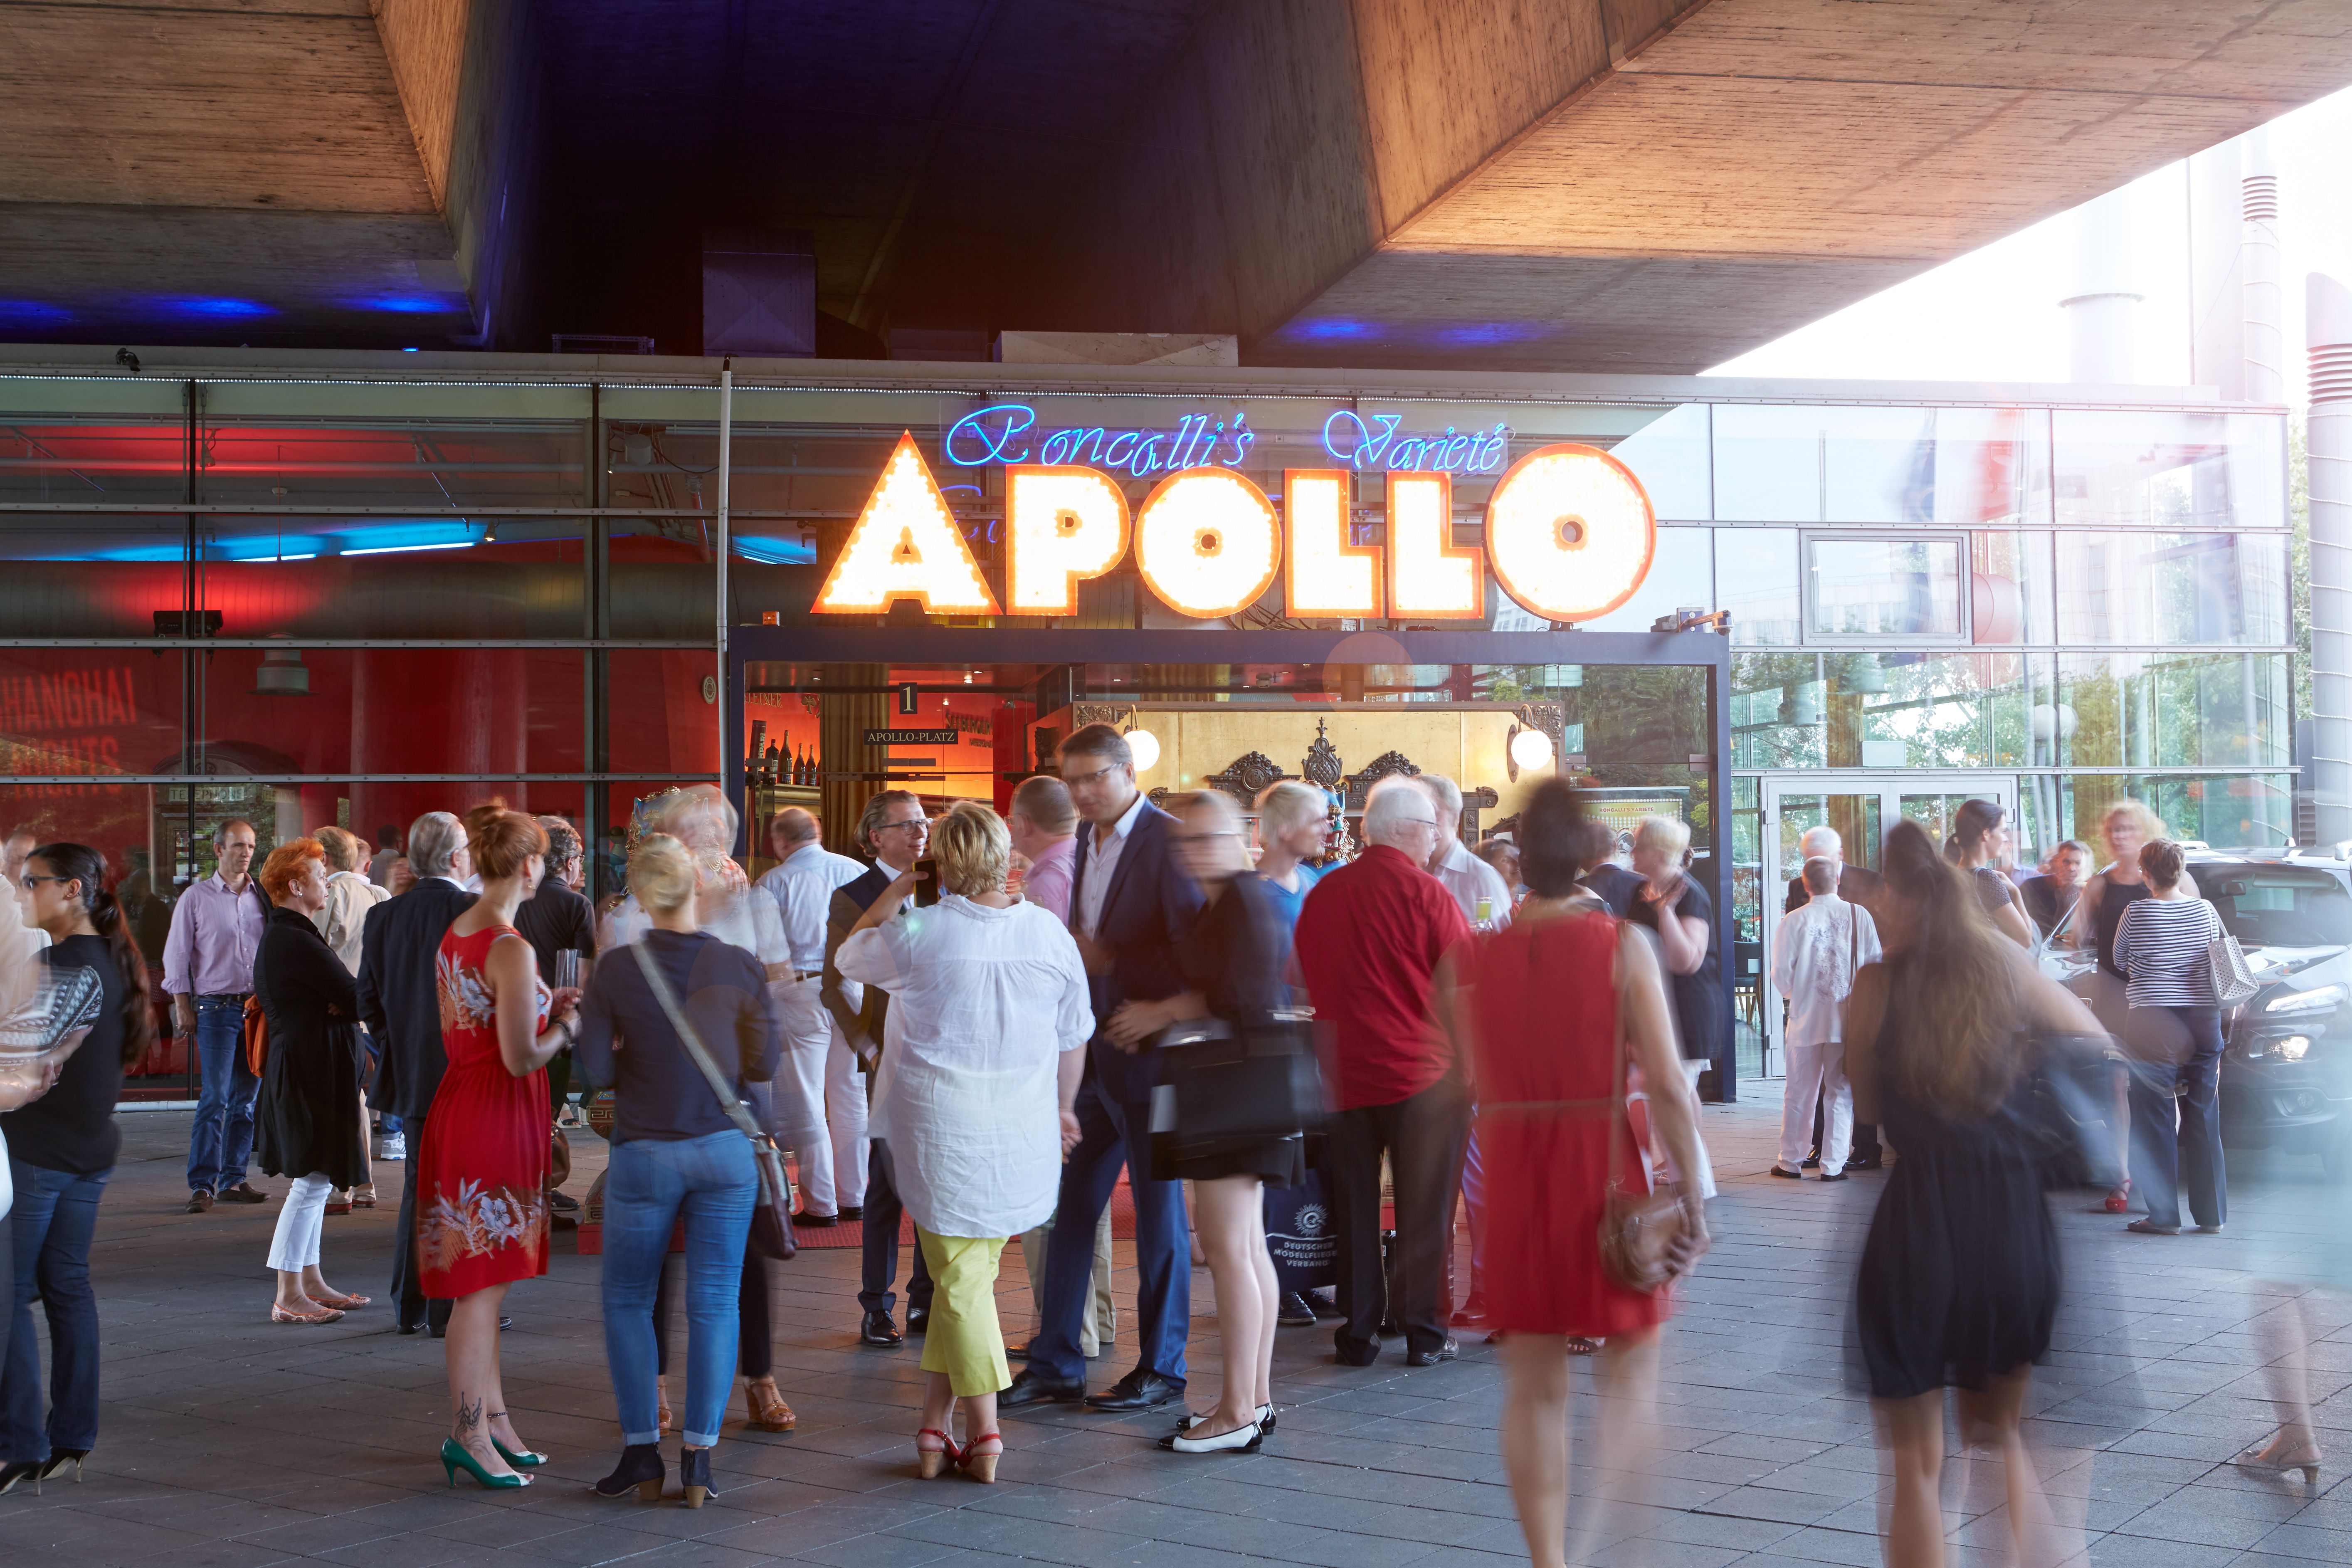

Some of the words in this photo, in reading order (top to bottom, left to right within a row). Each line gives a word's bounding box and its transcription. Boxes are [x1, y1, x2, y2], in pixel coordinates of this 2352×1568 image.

[946, 405, 1254, 477] Roncalli's
[1324, 410, 1506, 472] Varieté
[810, 427, 1658, 623] APOLLO
[0, 667, 137, 733] HANGHAI
[903, 686, 914, 711] 1
[867, 732, 955, 742] APOLLO-PLATZ
[170, 789, 244, 800] TEEPHONE
[1283, 1241, 1334, 1250] DEUTSCHER
[1273, 1248, 1338, 1259] MODELLFLIEGE
[1286, 1259, 1329, 1267] VERBAND
